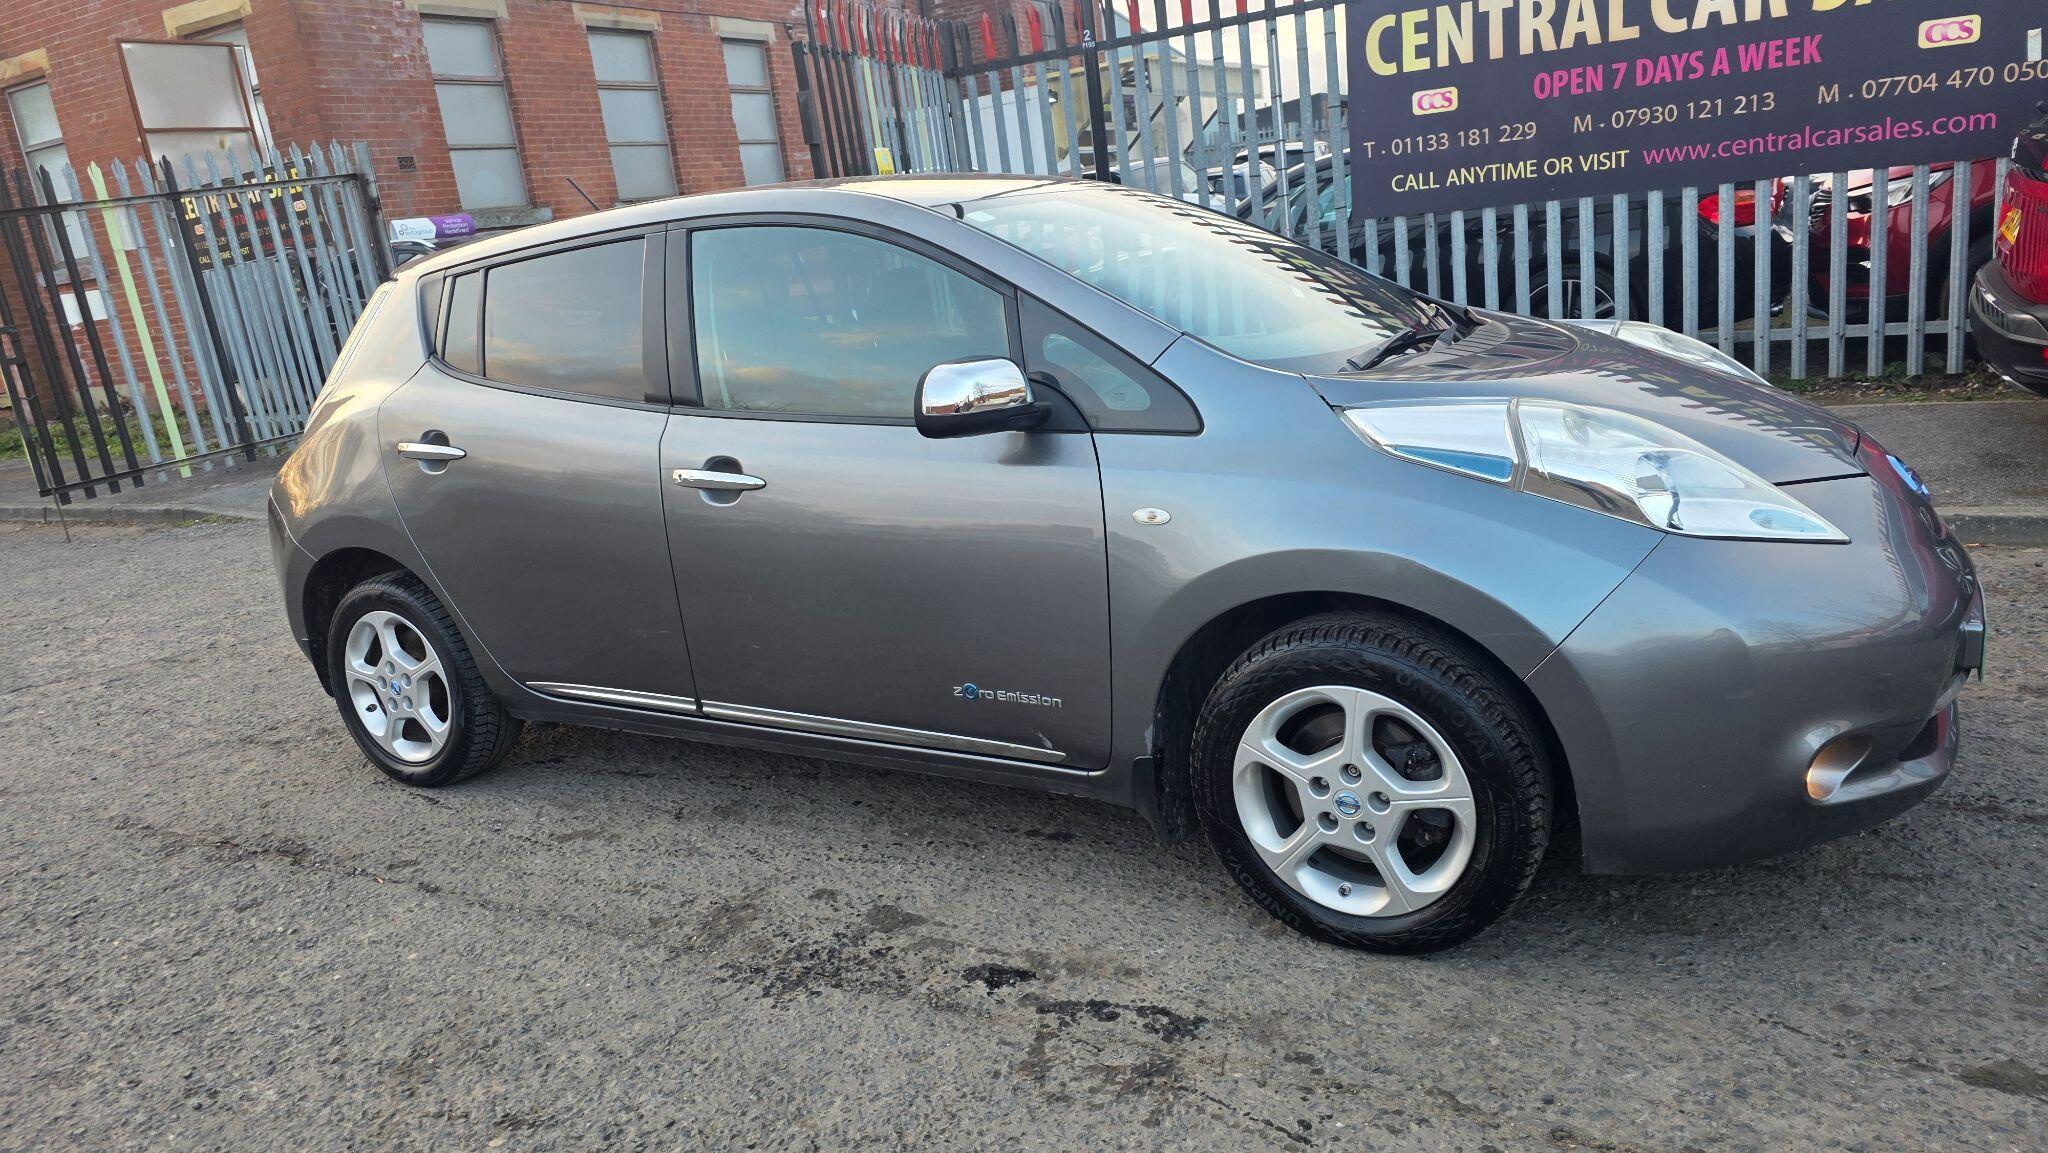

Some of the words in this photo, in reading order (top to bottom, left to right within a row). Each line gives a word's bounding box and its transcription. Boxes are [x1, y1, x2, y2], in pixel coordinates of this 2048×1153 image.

[1083, 29, 1091, 41] 2
[1365, 0, 1640, 76] CENTRAL
[1533, 64, 1603, 100] OPEN
[1611, 62, 1628, 90] 7
[1635, 50, 1704, 87] DAYS
[1711, 47, 1730, 77] A
[1738, 34, 1823, 73] WEEK
[1862, 72, 1939, 100] 07704
[1946, 65, 1995, 89] 470
[2003, 59, 2048, 83] 050
[1611, 104, 1678, 129] 07930
[1686, 98, 1723, 119] 121
[1733, 92, 1775, 115] 213
[1391, 132, 1450, 156] 01133
[1457, 128, 1490, 148] 181
[1499, 121, 1537, 143] 229
[1643, 112, 1998, 166] www.centralcarsales.com
[1391, 172, 1440, 193] CALL
[1446, 159, 1538, 187] ANYTIME
[1543, 155, 1573, 177] OR
[1579, 149, 1630, 172] VISIT
